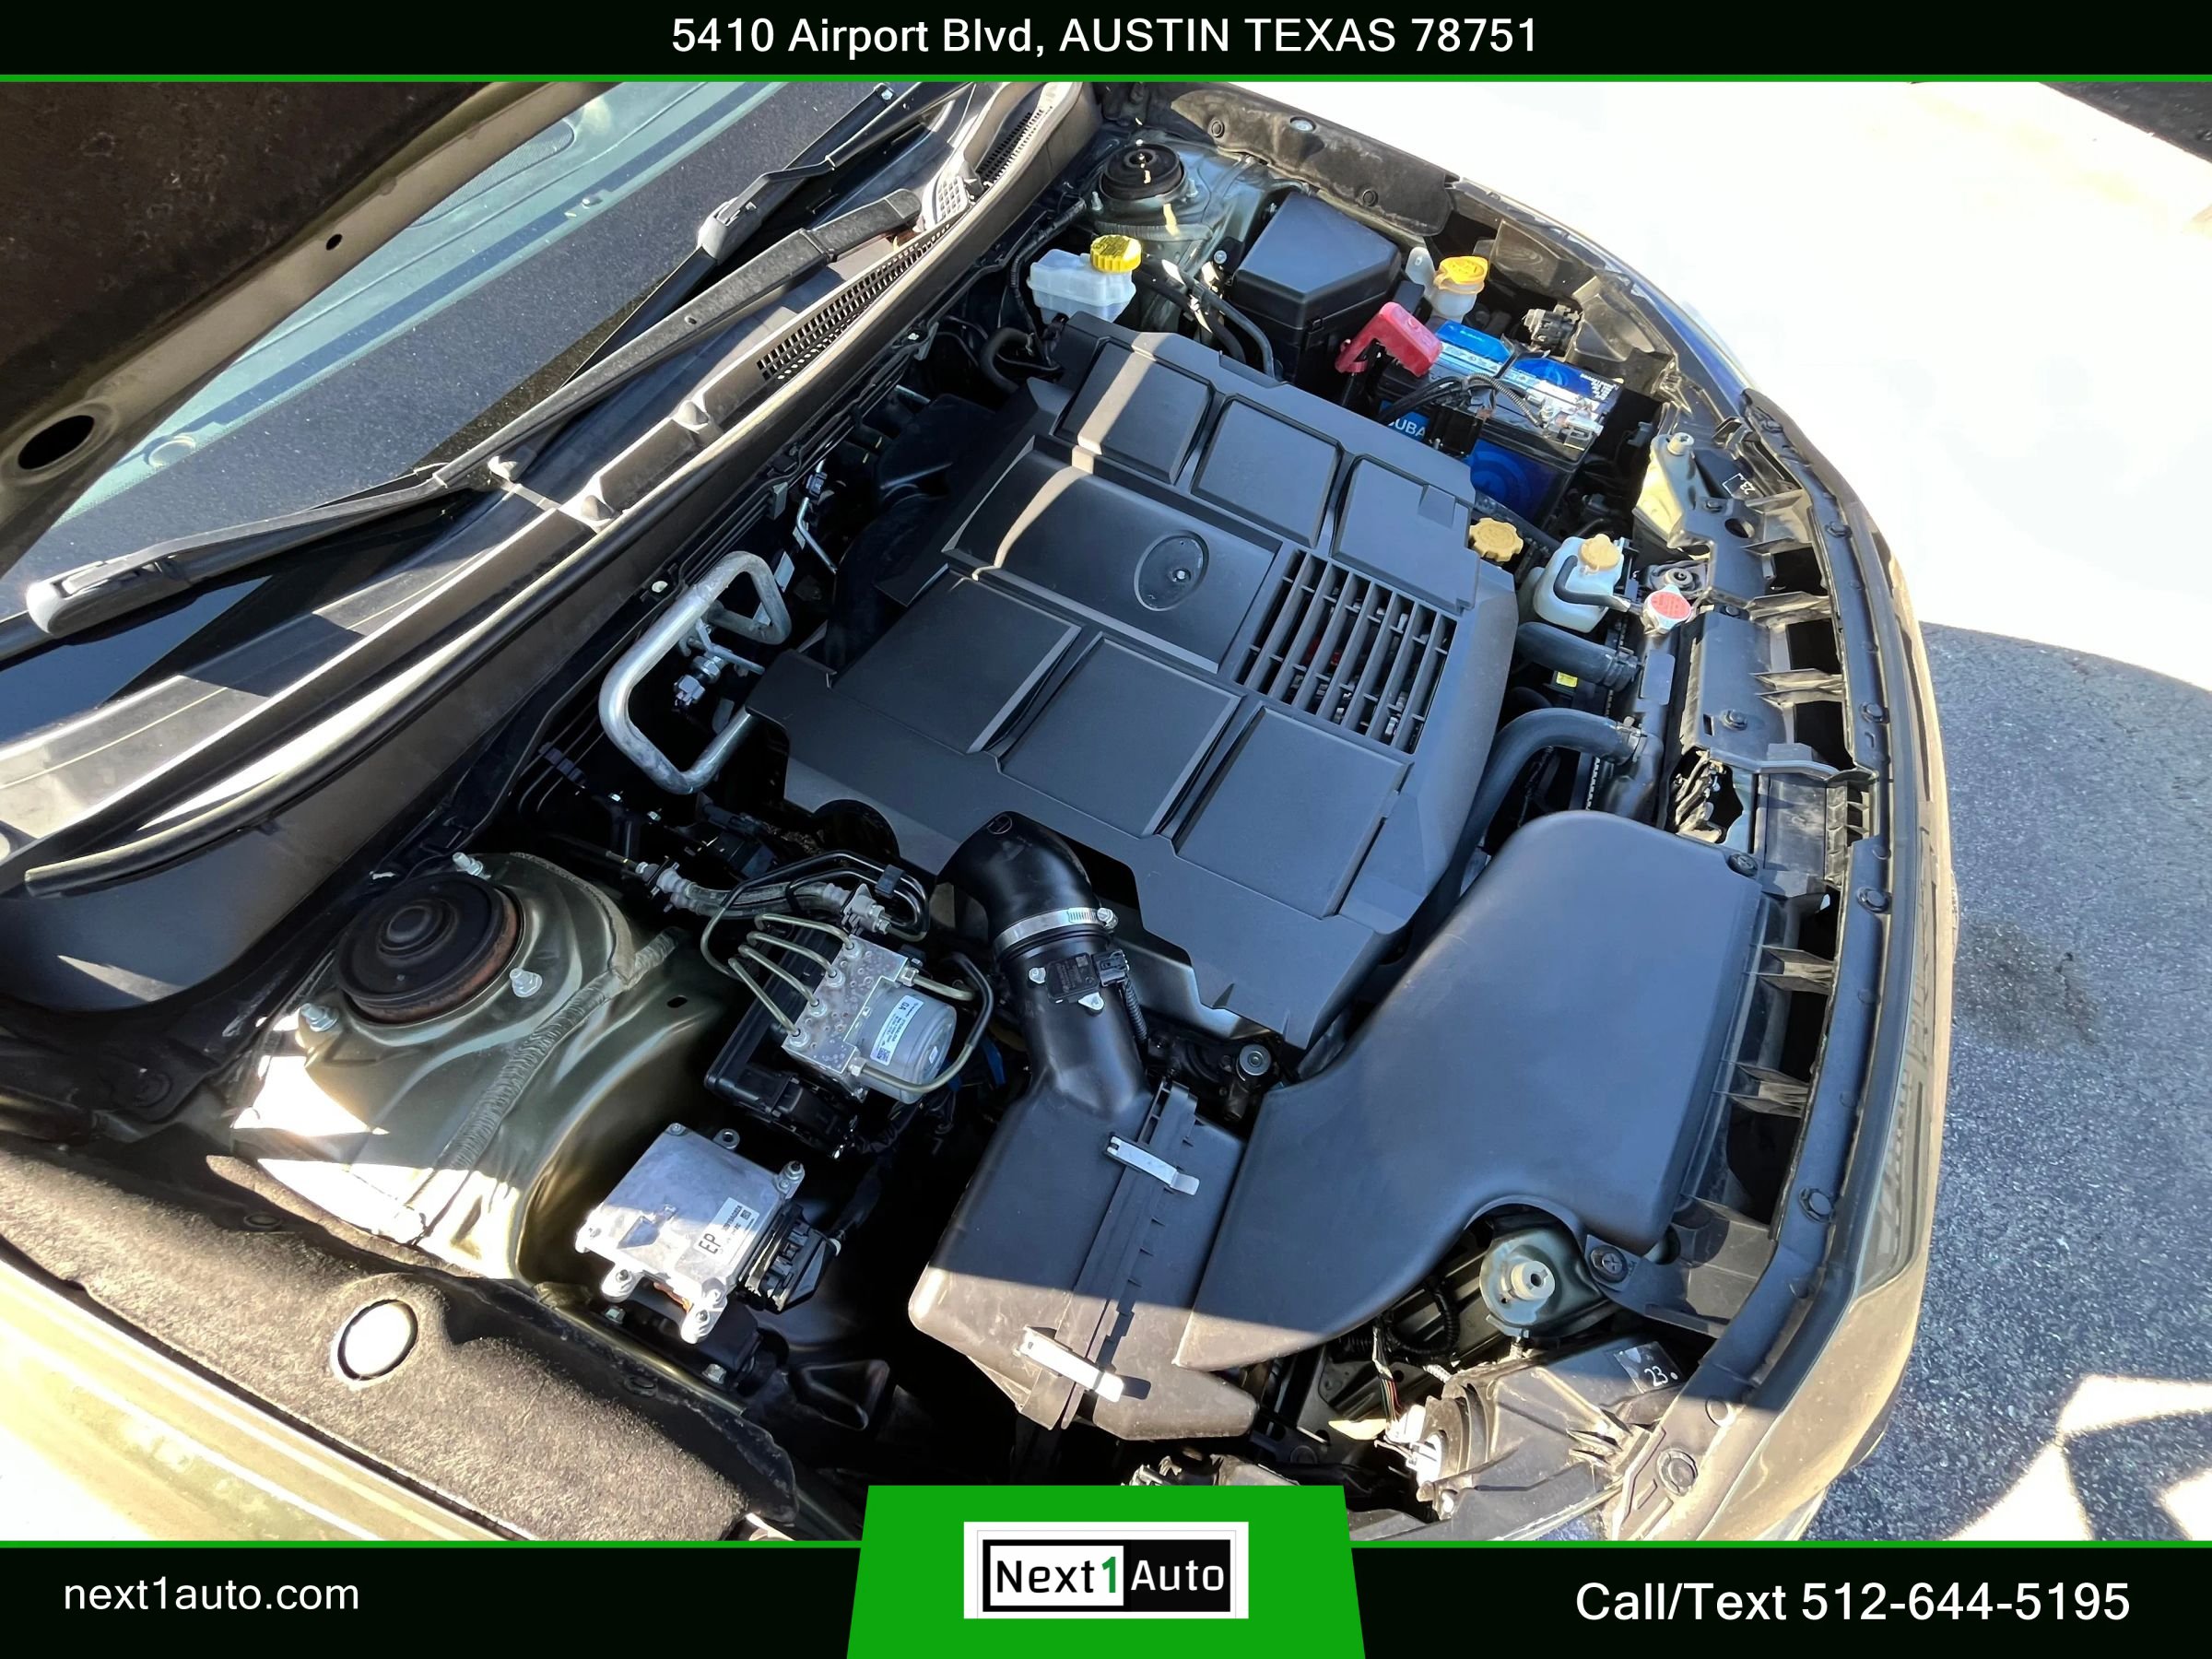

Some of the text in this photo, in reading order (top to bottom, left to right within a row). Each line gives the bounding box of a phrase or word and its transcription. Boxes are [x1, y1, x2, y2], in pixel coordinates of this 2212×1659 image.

[1388, 418, 1427, 438] UBA
[698, 1232, 722, 1254] EP
[1643, 1365, 1669, 1387] 23
